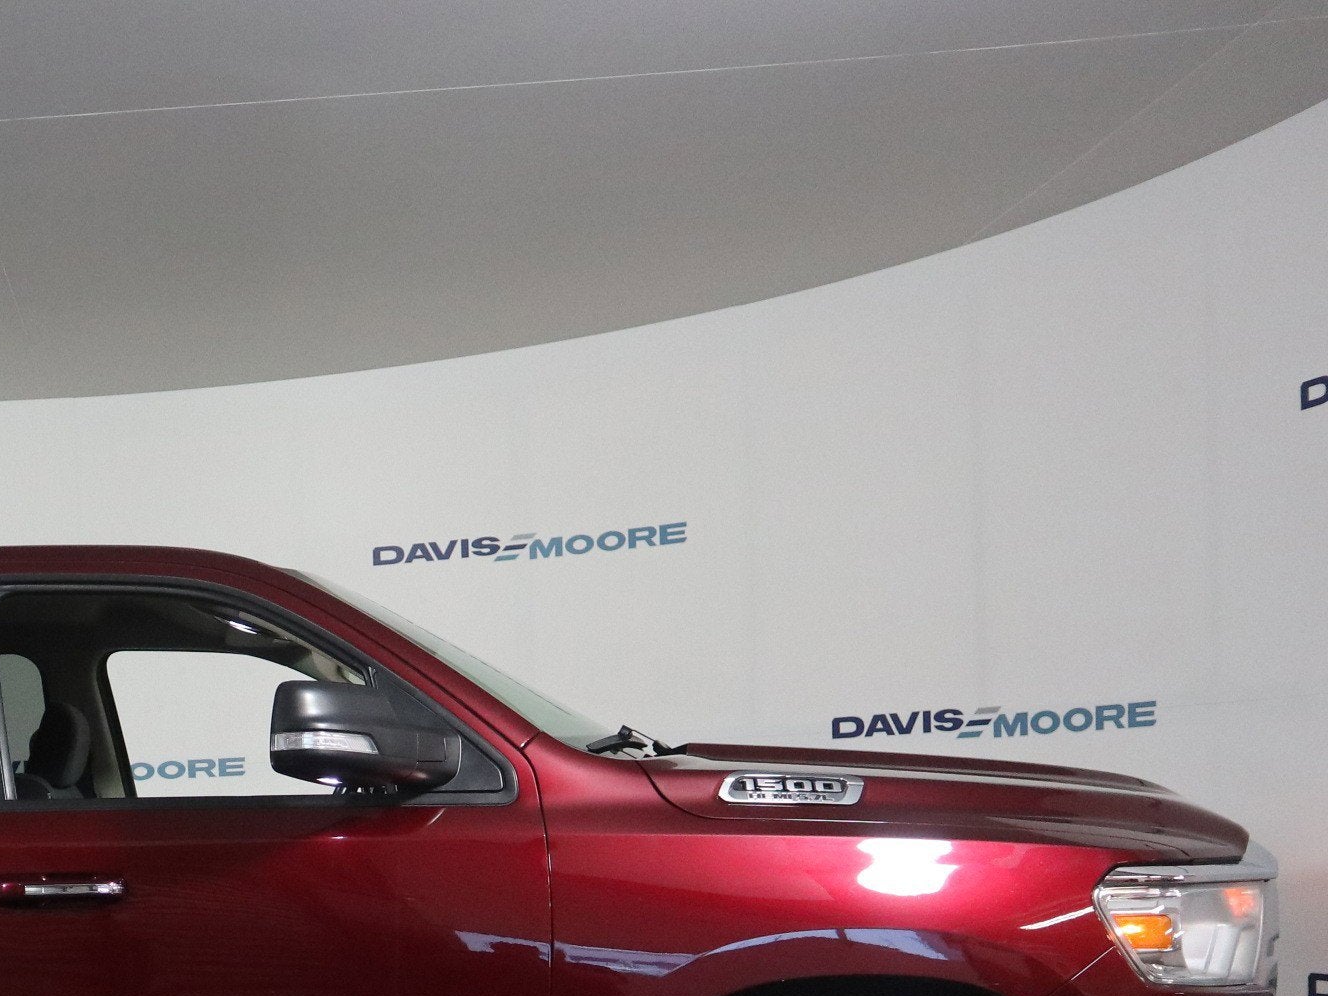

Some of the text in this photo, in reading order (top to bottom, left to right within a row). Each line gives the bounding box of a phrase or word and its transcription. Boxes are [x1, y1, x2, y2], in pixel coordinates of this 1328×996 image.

[372, 521, 688, 567] DAVIS MOORE
[831, 701, 1157, 739] DAVIS MOORE
[130, 757, 246, 781] OORE
[738, 779, 843, 792] 1500
